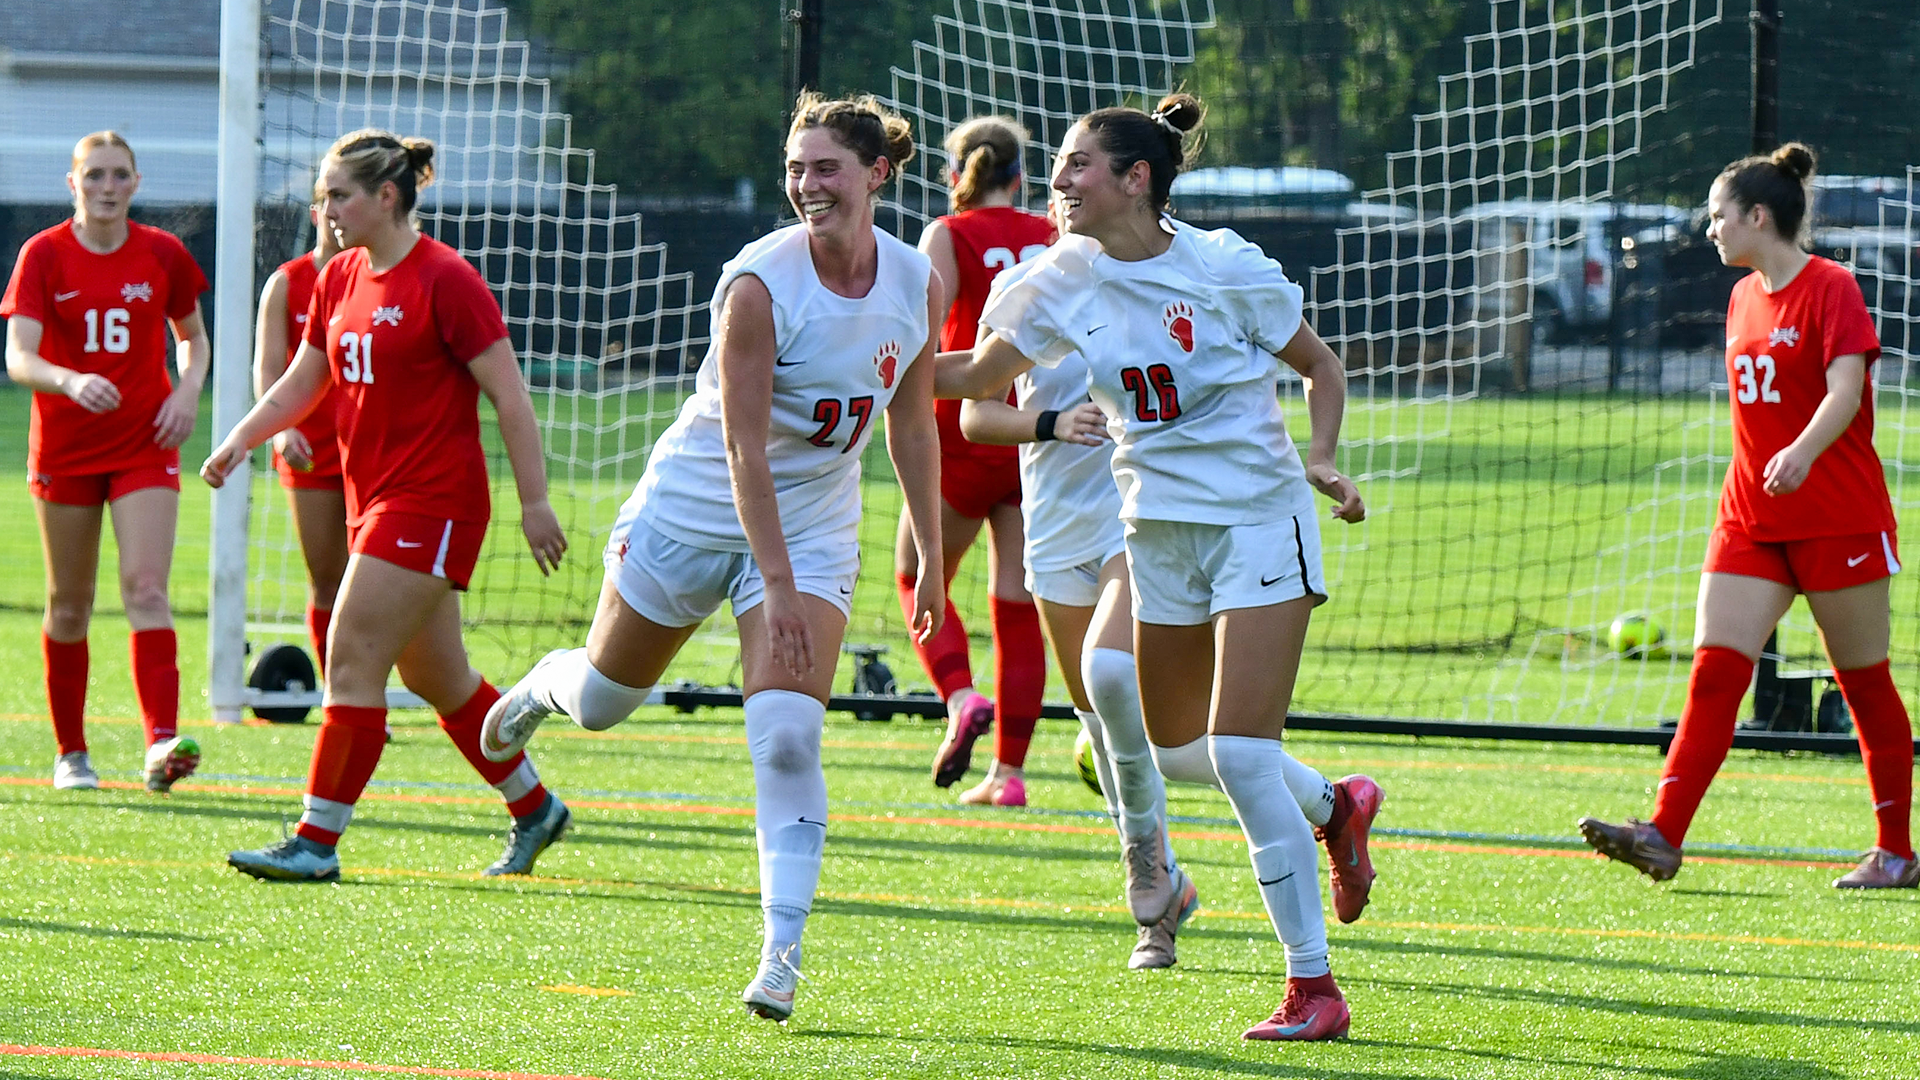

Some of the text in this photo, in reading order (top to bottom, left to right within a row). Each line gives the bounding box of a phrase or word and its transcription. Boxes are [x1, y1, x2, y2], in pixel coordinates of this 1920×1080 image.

[84, 309, 130, 353] 16
[340, 333, 374, 384] 31
[1734, 355, 1781, 404] 32
[1121, 364, 1180, 422] 26
[807, 396, 874, 454] 27
